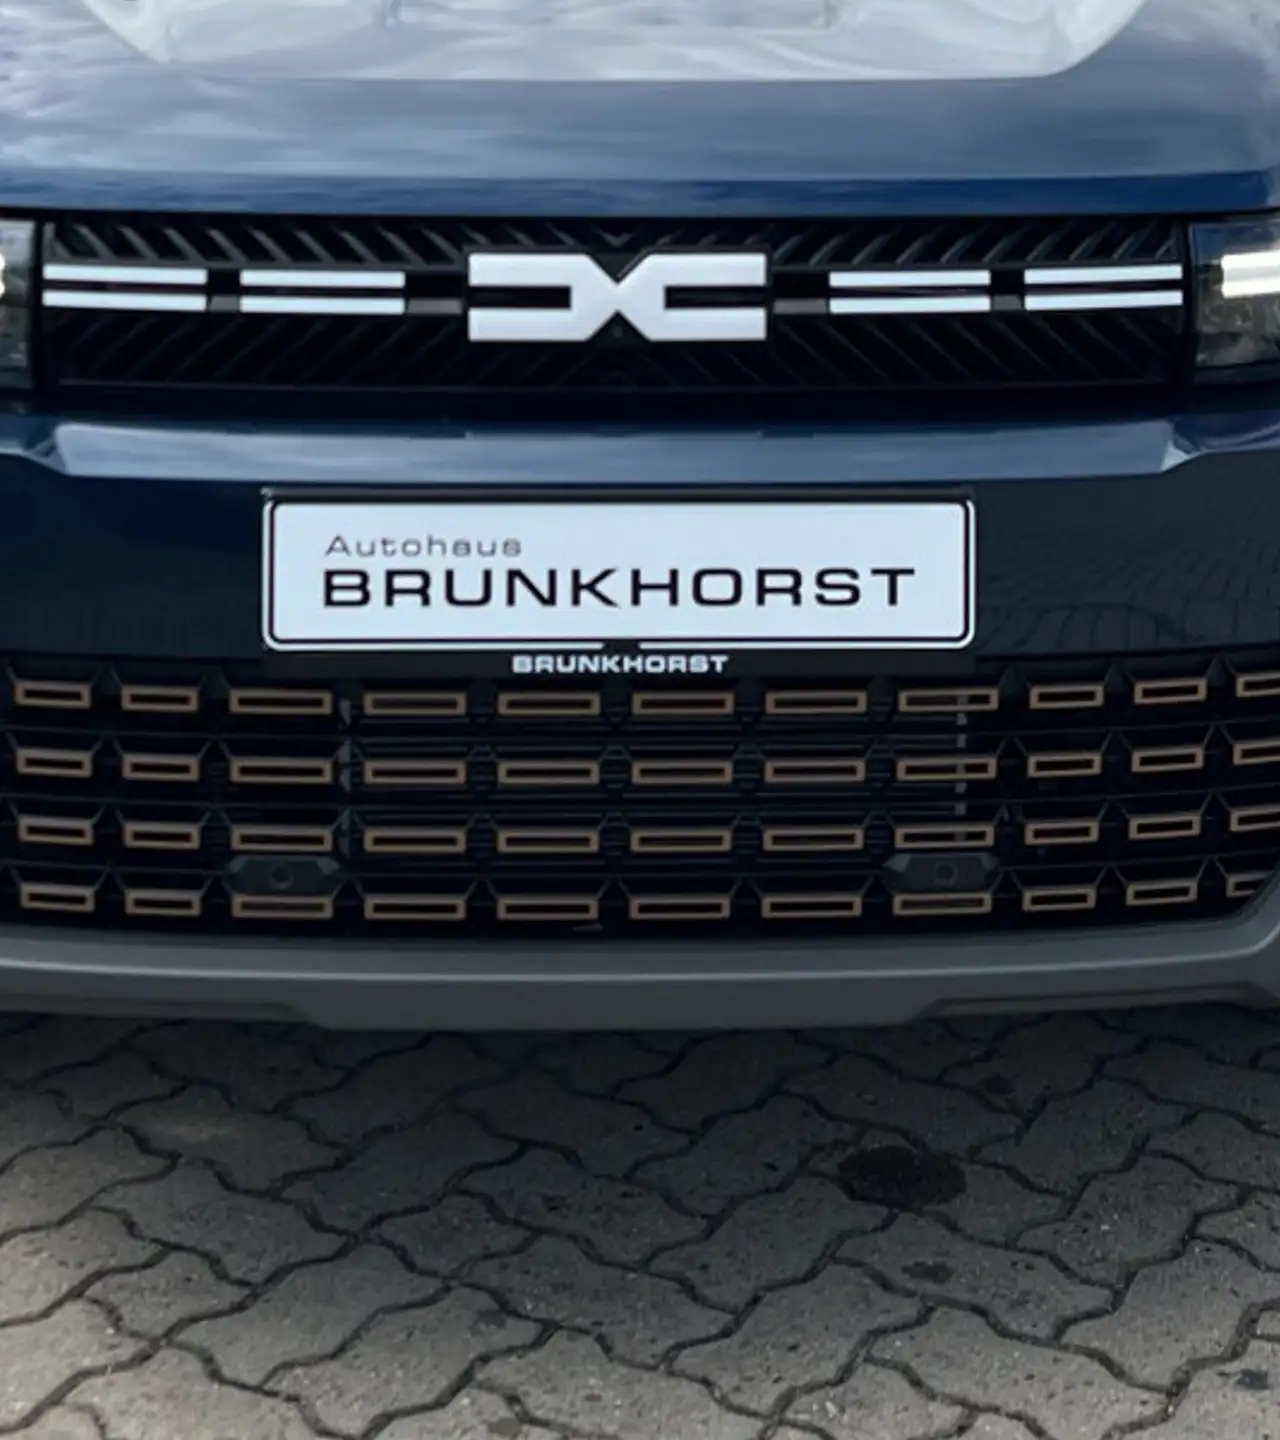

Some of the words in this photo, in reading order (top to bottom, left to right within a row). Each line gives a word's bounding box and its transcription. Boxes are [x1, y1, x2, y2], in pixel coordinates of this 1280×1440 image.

[325, 534, 522, 558] Autohaus
[322, 567, 916, 608] BRUNKHORST
[512, 655, 729, 674] BRUNKHORST
